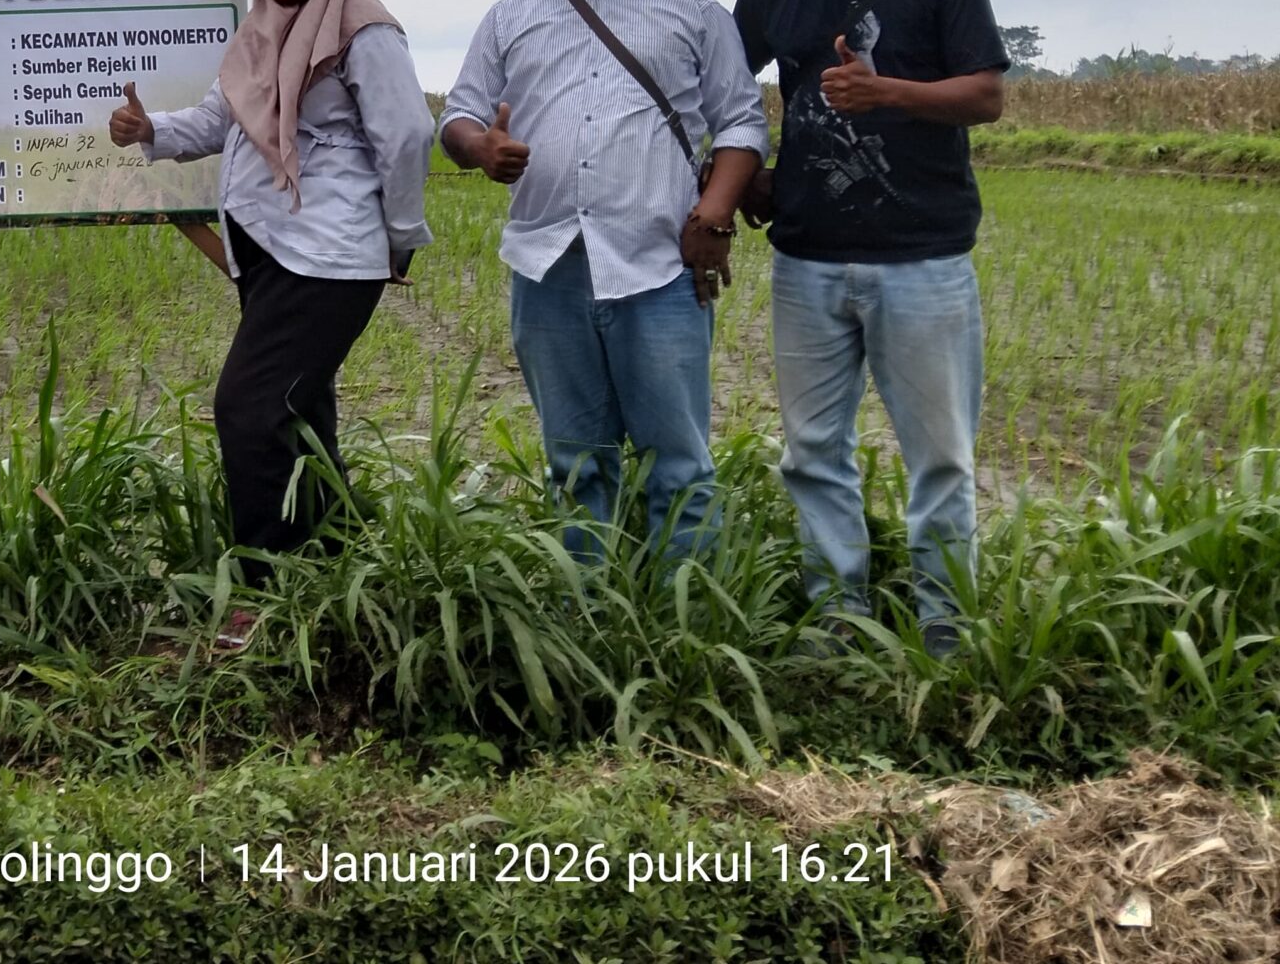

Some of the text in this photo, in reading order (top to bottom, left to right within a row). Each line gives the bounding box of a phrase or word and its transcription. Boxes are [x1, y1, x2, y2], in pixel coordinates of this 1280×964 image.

[20, 31, 118, 49] KECAMATAN
[122, 27, 228, 46] WONOMERTO
[22, 58, 82, 75] Sumber
[87, 56, 136, 76] Rejeki
[141, 55, 157, 71] III
[23, 83, 72, 103] Sepuh
[76, 81, 135, 98] Gemb
[24, 109, 83, 125] Sulihan
[77, 135, 96, 152] 32
